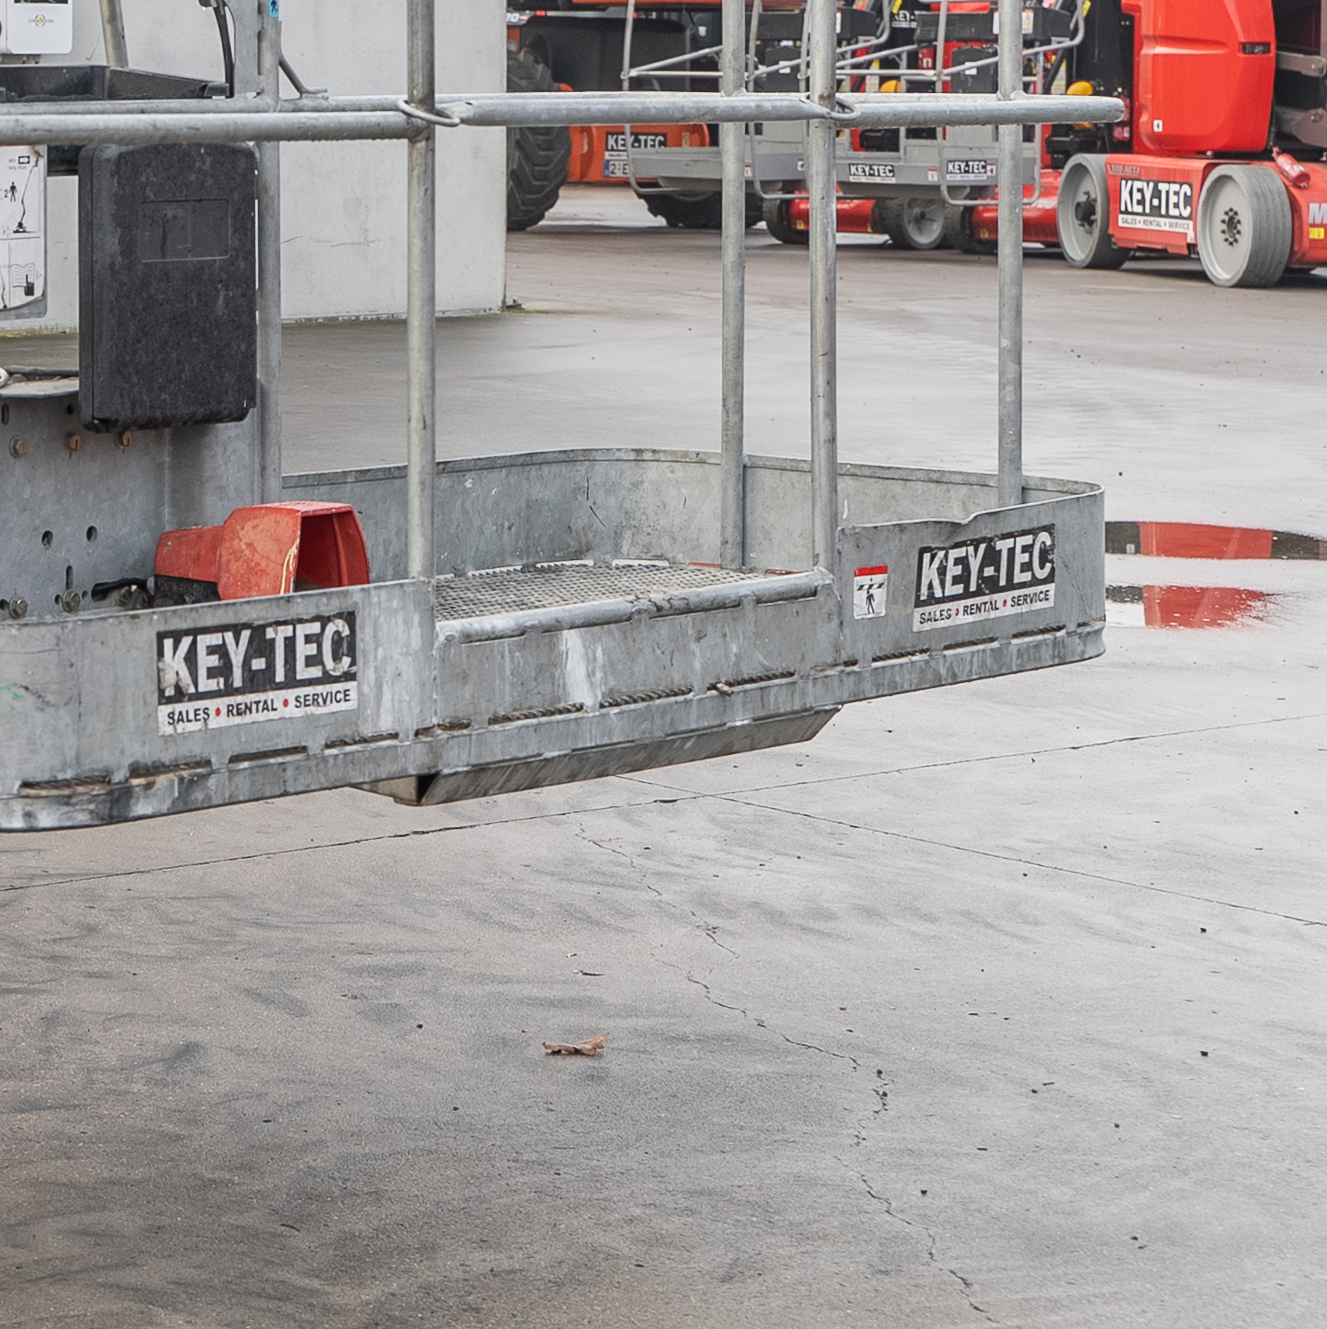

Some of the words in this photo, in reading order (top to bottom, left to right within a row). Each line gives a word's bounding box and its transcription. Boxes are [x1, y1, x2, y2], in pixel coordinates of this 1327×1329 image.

[850, 164, 894, 177] KEY-TEC
[947, 161, 986, 173] KEY-TEC
[1120, 179, 1192, 218] KEY-TEC
[1121, 217, 1137, 225] SALES
[920, 531, 1052, 600] KEY-TEC
[919, 608, 952, 624] SALES
[962, 601, 1000, 617] RENTAL
[1010, 590, 1050, 607] SERVICE
[162, 618, 352, 697] KEY-TEC
[167, 707, 210, 725] SALES
[227, 699, 278, 717] RENTAL
[294, 688, 351, 708] SERVICE
